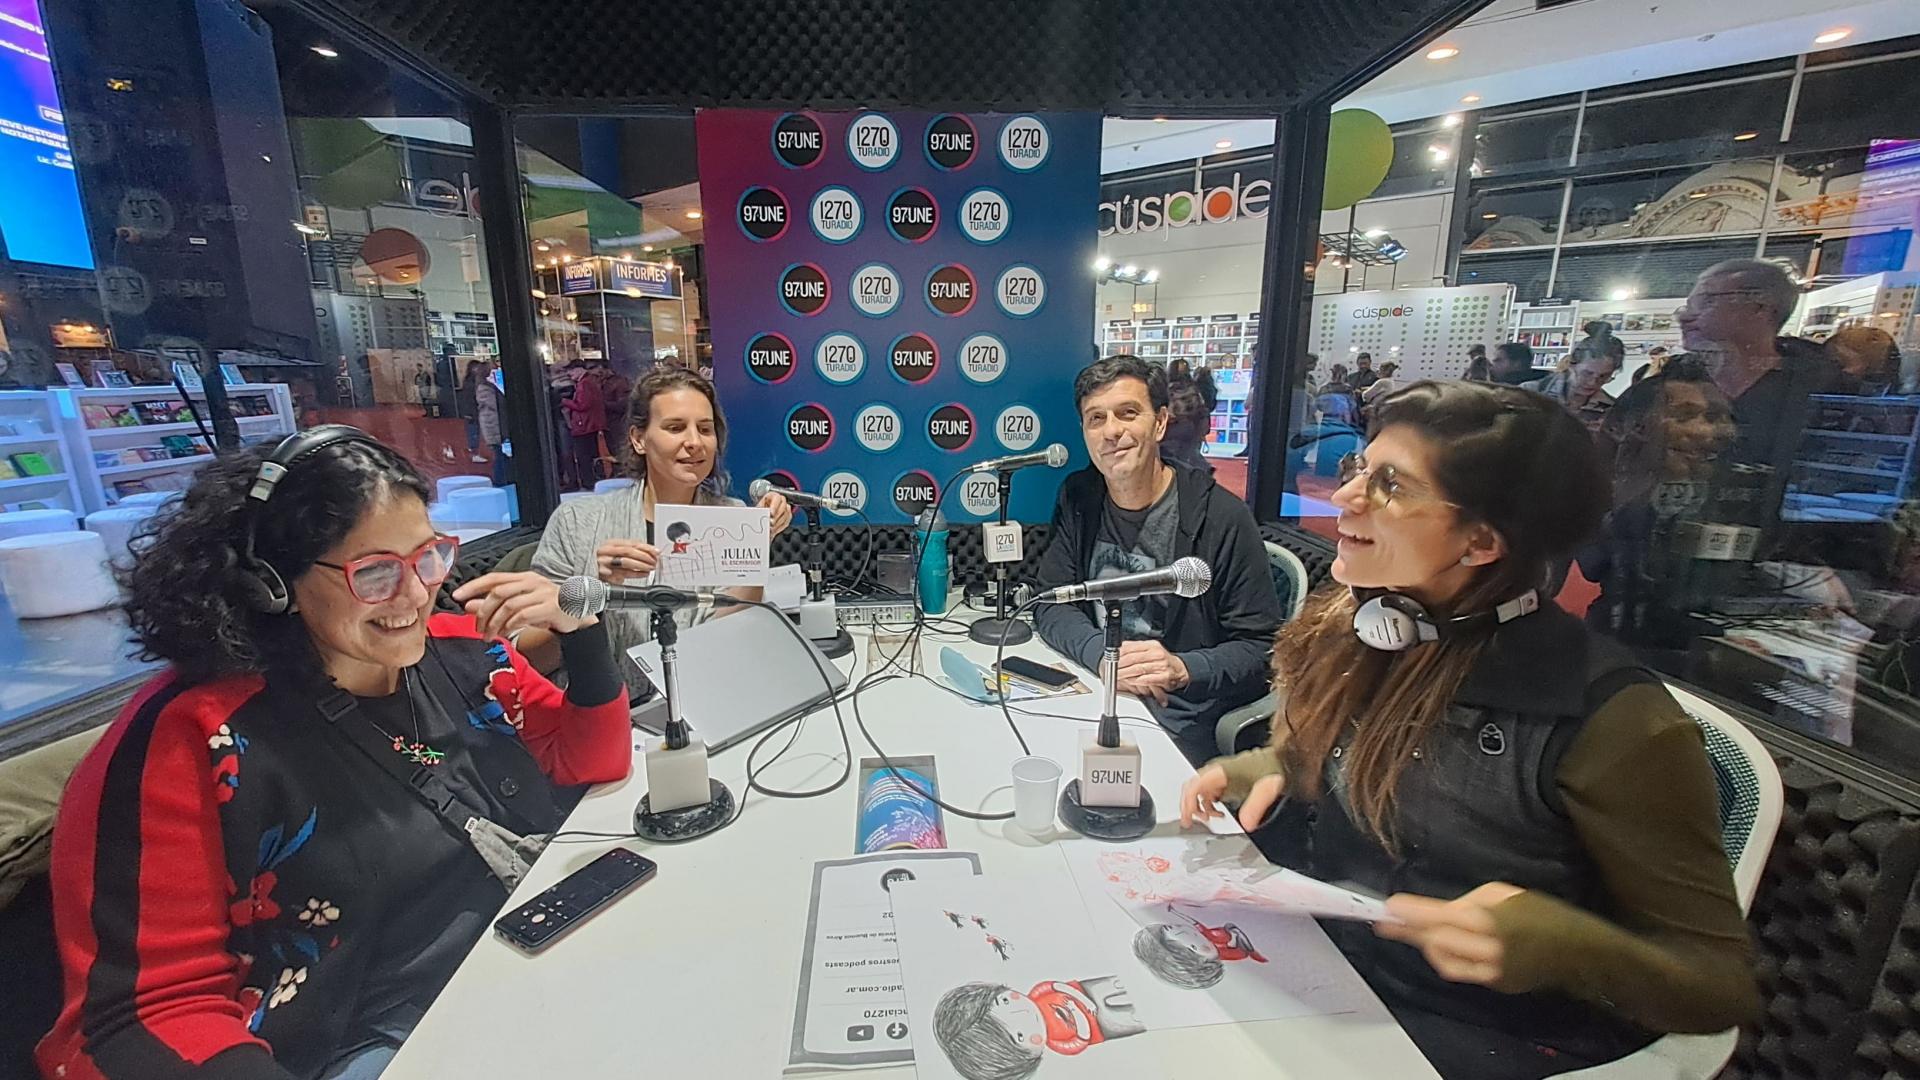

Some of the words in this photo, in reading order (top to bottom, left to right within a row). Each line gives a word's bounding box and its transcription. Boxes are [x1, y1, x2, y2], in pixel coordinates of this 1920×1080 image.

[778, 133, 820, 150] 97UNE
[856, 126, 889, 148] 1270
[930, 133, 972, 151] 97UNE
[1008, 128, 1041, 150] 1270
[743, 206, 785, 223] 97UNE
[820, 200, 852, 221] 1270
[892, 206, 933, 224] 97UNE
[969, 201, 1001, 222] 1270
[1098, 172, 1272, 242] cúspide
[616, 264, 667, 283] INFORMES
[784, 280, 825, 298] 97UNE
[860, 276, 891, 296] 1270
[930, 281, 971, 298] 97UNE
[1005, 277, 1036, 297] 1270
[1352, 304, 1414, 321] cúspide
[751, 349, 790, 366] 97UNE
[825, 345, 856, 364] 1270
[894, 349, 933, 367] 97UNE
[967, 345, 999, 364] 1270
[790, 420, 829, 436] 97UNE
[863, 415, 894, 433] 1270
[930, 420, 969, 435] 97UNE
[1003, 415, 1034, 433] 1270
[828, 481, 859, 499] 1270
[895, 485, 934, 502] 97UNE
[967, 480, 998, 498] 1270
[995, 533, 1015, 545] 1270
[1091, 769, 1133, 785] 97UNE
